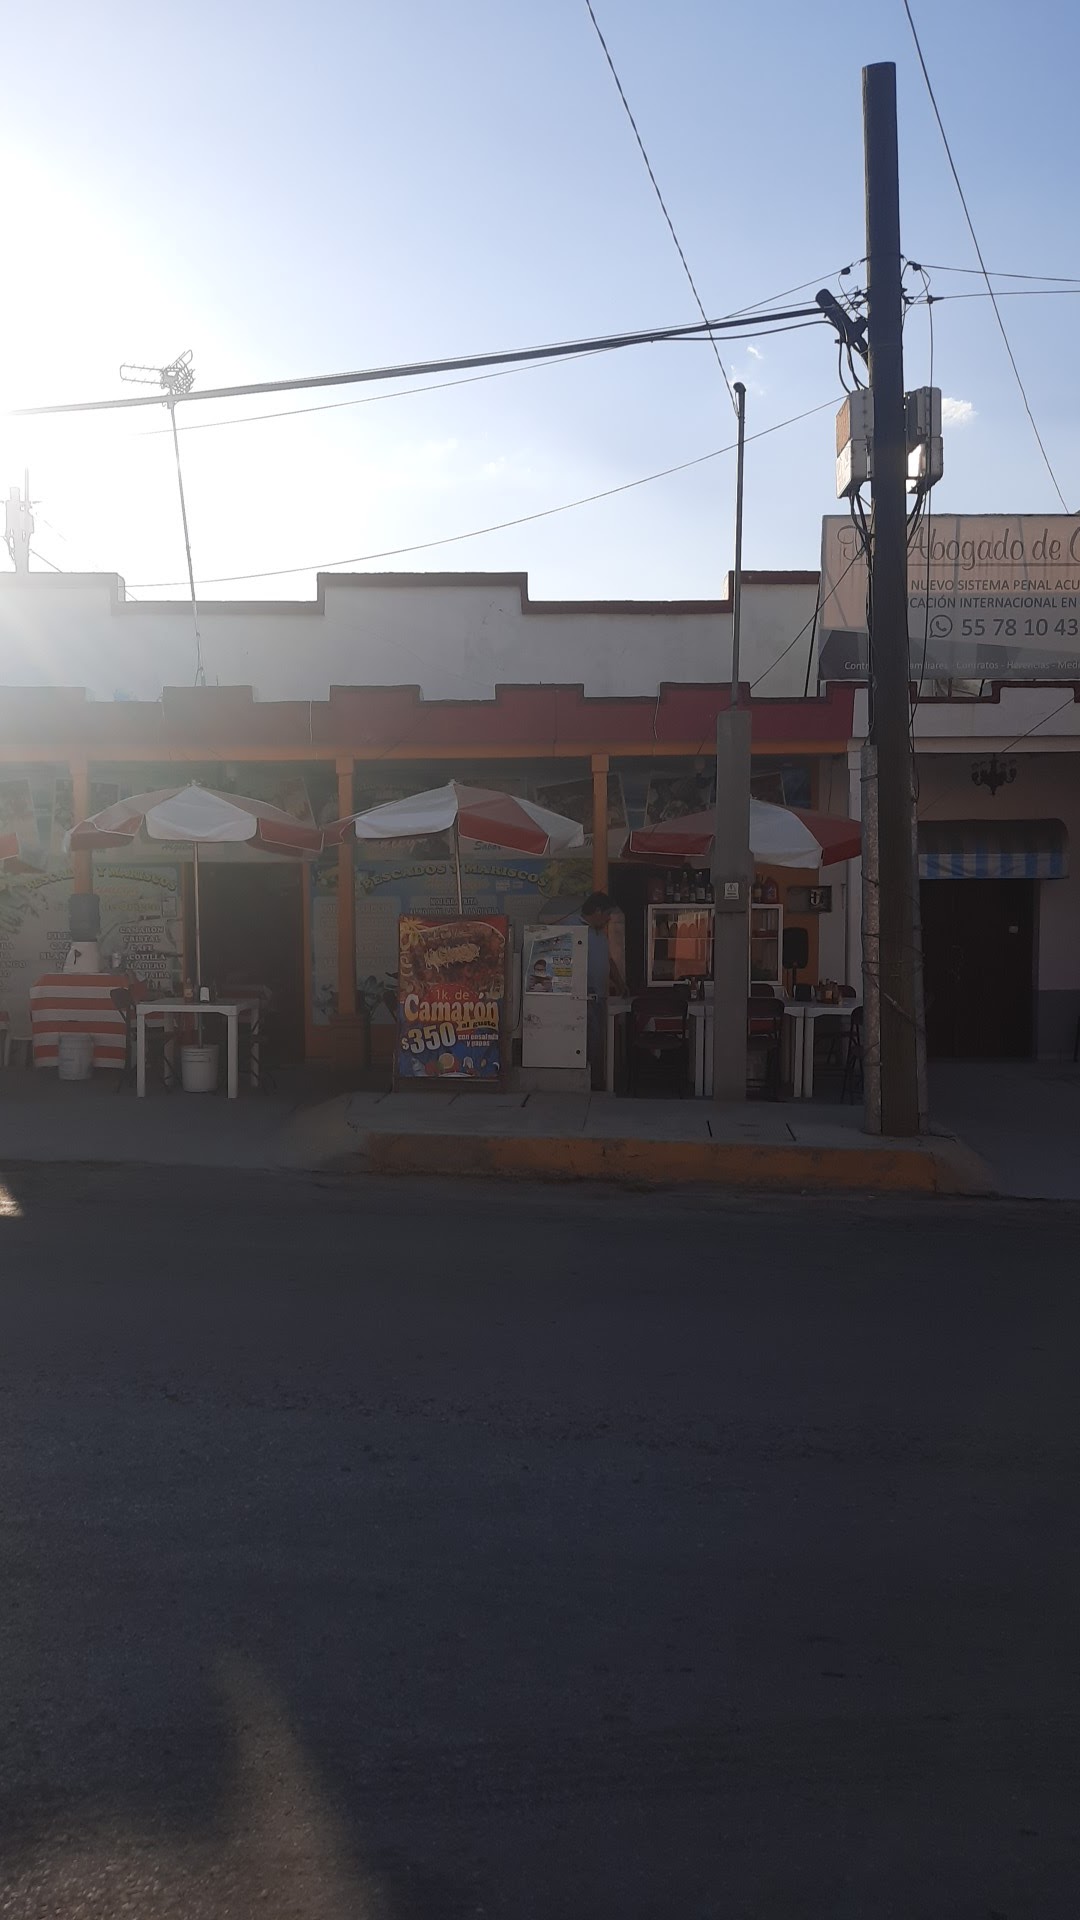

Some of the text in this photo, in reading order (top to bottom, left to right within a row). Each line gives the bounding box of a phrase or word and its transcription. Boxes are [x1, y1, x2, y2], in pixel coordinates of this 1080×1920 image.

[907, 526, 1025, 571] Abogado
[1032, 528, 1061, 561] de
[911, 579, 954, 591] NUEVO
[957, 579, 1008, 591] SISTEMA
[1013, 579, 1052, 591] PENAL
[960, 597, 1058, 609] INTERNACIONAL
[1062, 597, 1077, 608] EN
[961, 618, 1079, 637] 55 78 10 43
[956, 660, 999, 671] Contratos
[360, 863, 446, 890] PESCADOS
[465, 863, 550, 887] MARISCOS
[454, 989, 470, 1000] de
[404, 992, 499, 1023] Camarón
[461, 1020, 497, 1029] al gusto
[401, 1021, 457, 1055] $350
